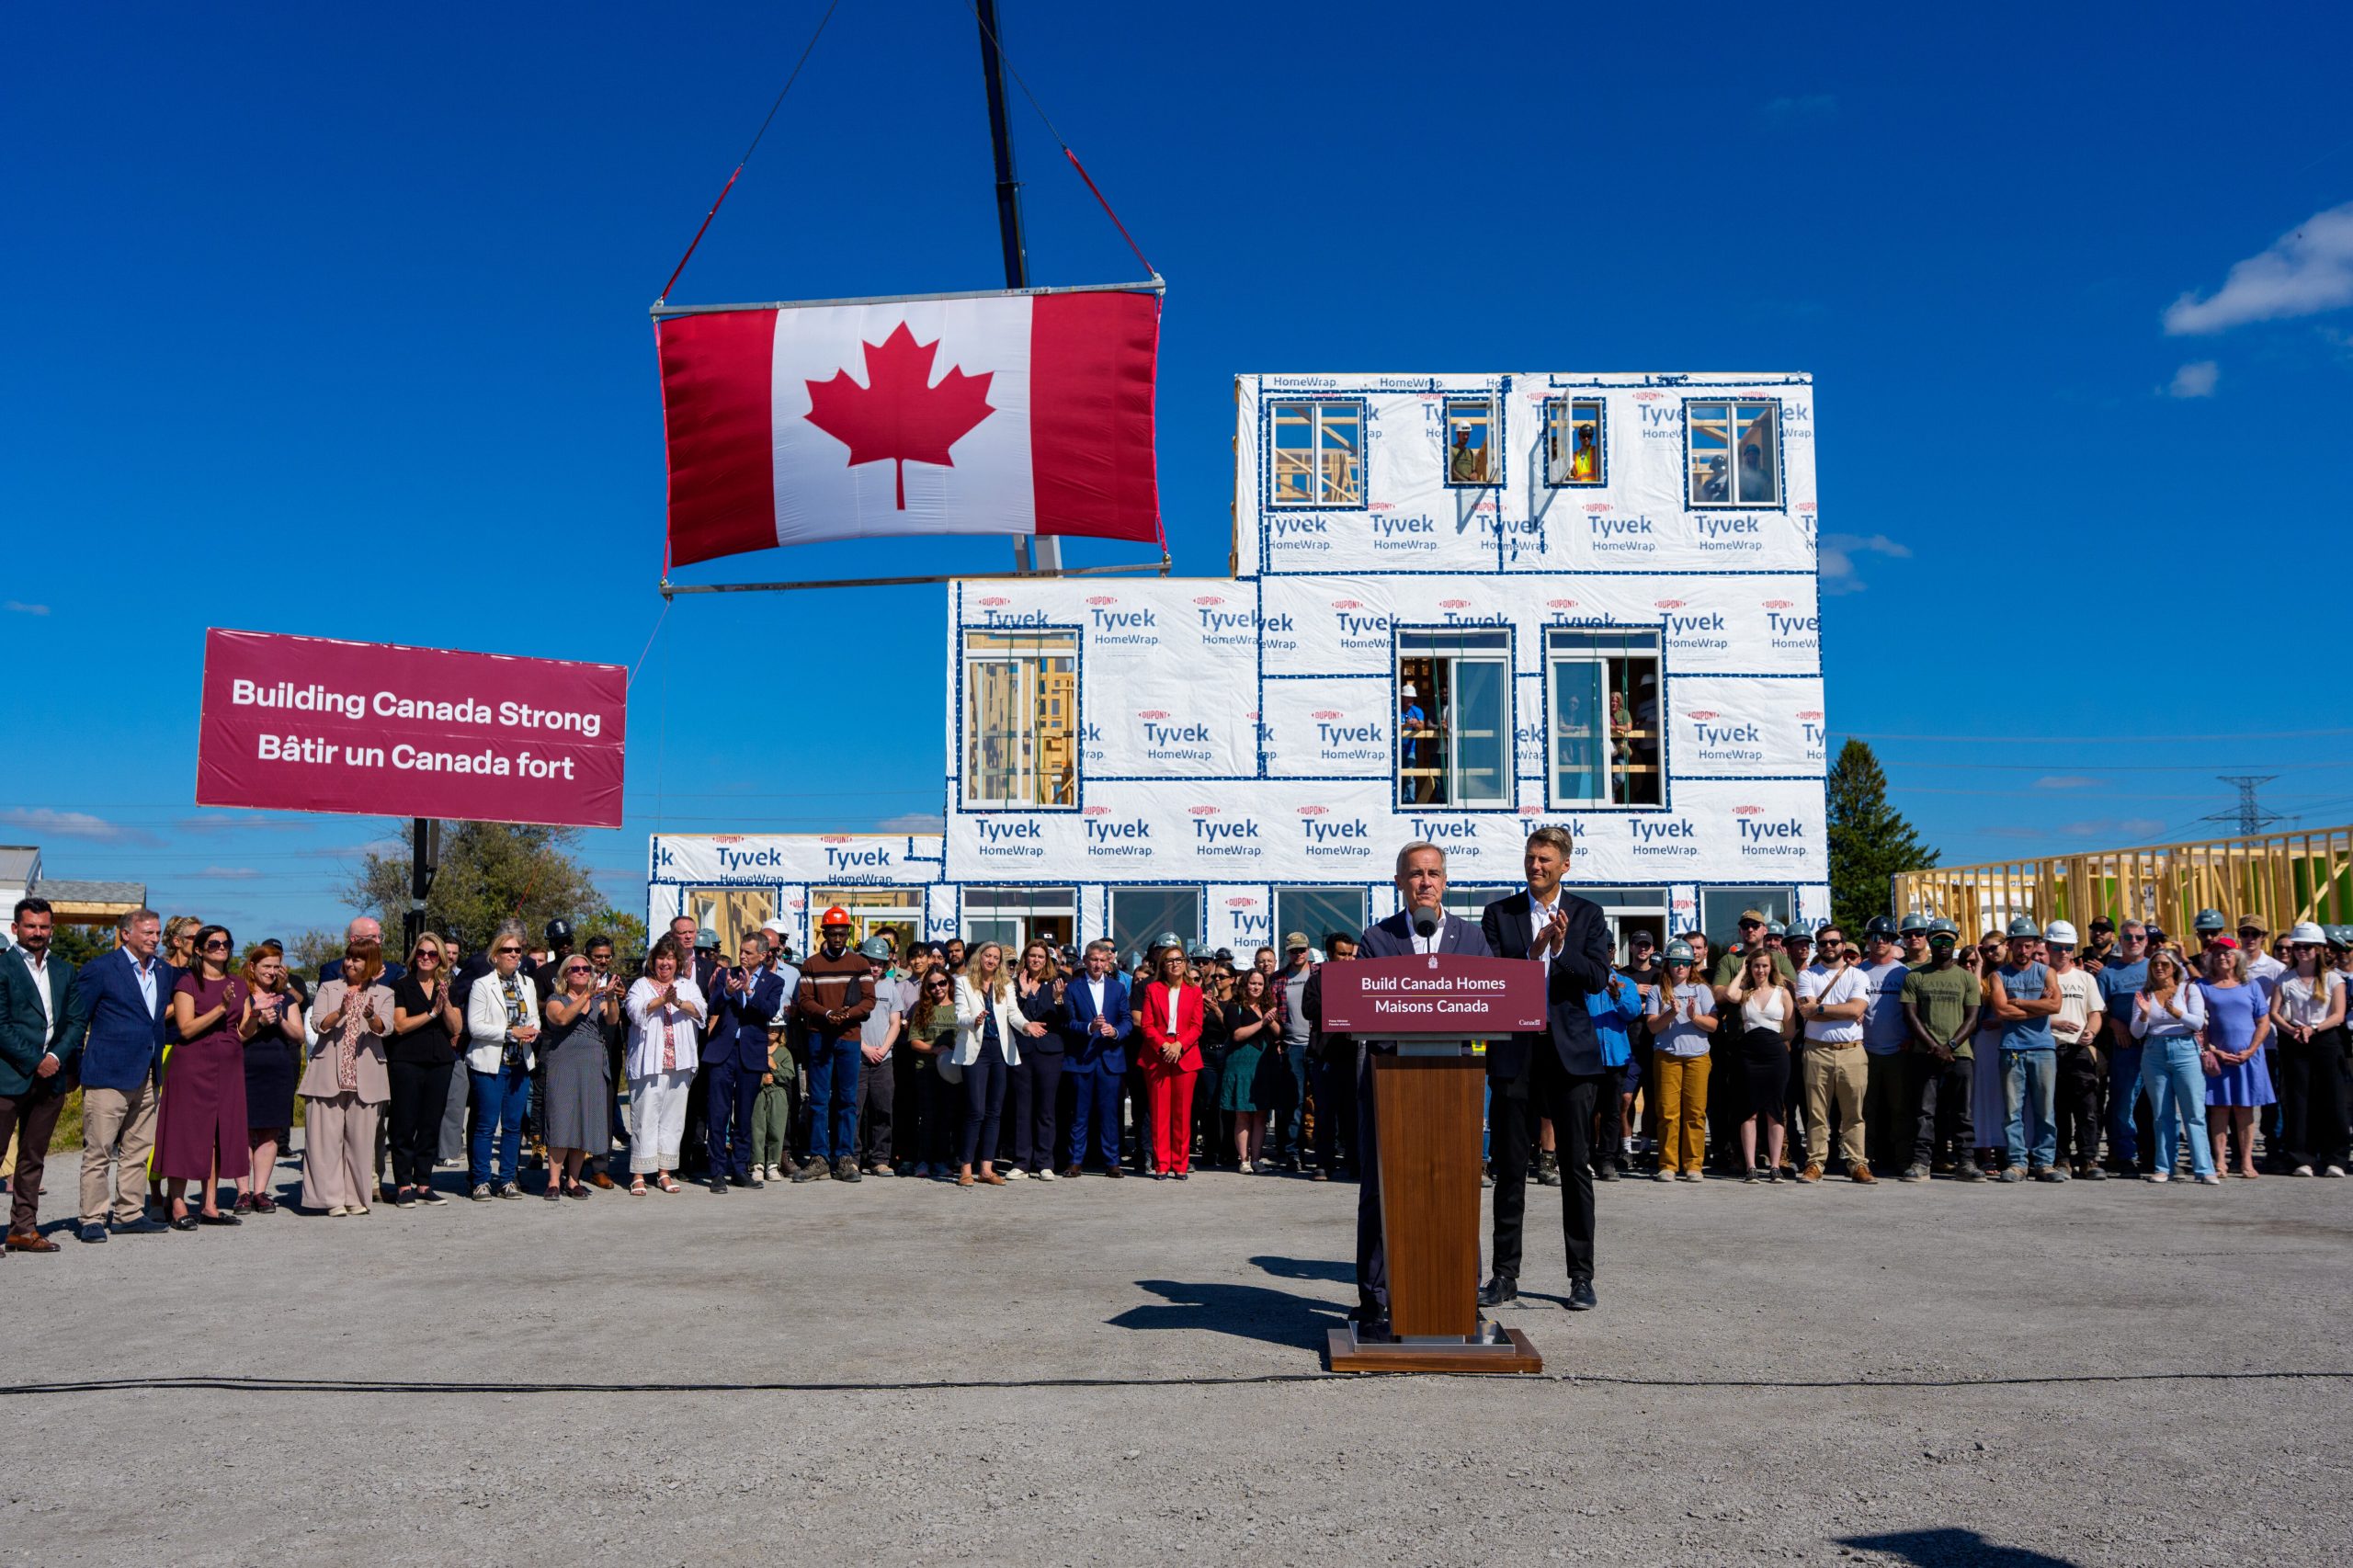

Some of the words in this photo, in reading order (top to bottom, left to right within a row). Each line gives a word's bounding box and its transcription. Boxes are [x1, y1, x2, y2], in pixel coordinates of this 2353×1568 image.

[1274, 377, 1336, 388] HomeWrap
[1380, 378, 1443, 389] HomeWrp
[1638, 403, 1683, 426] Tyve
[1799, 503, 1816, 512] DUPO
[1263, 514, 1327, 538] Tyvek
[1370, 514, 1435, 538] Tyvek
[1587, 515, 1653, 539] Tyvek
[1694, 515, 1759, 539] Tyvek
[1374, 540, 1438, 552] HomeWrap
[1592, 540, 1656, 552] HomeWrap
[1699, 540, 1762, 551] HomeWrap
[1091, 608, 1156, 632] Tyvek
[1659, 612, 1724, 636] Tyvek
[1767, 612, 1818, 636] Tyve
[1095, 634, 1159, 646] HomeWrap
[1202, 634, 1258, 645] HomeWra
[1261, 639, 1297, 651] eWrap
[1340, 639, 1392, 648] HomeWr
[1771, 639, 1817, 648] HomeW
[232, 678, 366, 720] Building
[372, 690, 492, 725] Canada
[498, 701, 601, 737] Strong
[1142, 710, 1167, 720] DUPONT
[1314, 710, 1341, 720] DUPONT
[1143, 722, 1209, 747] Tyvek
[1317, 722, 1382, 747] Tyvek
[1694, 722, 1759, 747] Tyvek
[257, 733, 338, 764] Bâtir
[345, 747, 384, 767] un
[392, 744, 510, 777] Canada
[517, 751, 574, 780] fort
[1148, 749, 1211, 761] HomeWrap
[1321, 749, 1385, 761] HomeWrap
[1699, 749, 1763, 761] HomeWrap
[1192, 806, 1217, 815] DUPONT
[1301, 806, 1326, 815] DUPONT
[975, 818, 1040, 843] Tyvek
[1084, 818, 1150, 843] Tyvek
[1192, 818, 1258, 843] Tyvek
[1302, 818, 1368, 843] Tyvek
[1410, 818, 1477, 843] Tyvek
[1628, 818, 1694, 843] Tyvek
[1737, 818, 1802, 843] Tyvek
[979, 845, 1043, 858] HomeWrap
[1087, 845, 1153, 857] HomeWrap
[1197, 845, 1261, 857] HomeWrap
[1306, 845, 1370, 858] HomeWrap
[1443, 845, 1480, 857] eWrap
[1632, 845, 1698, 857] HomeWrap
[1742, 845, 1806, 857] HomeWrap
[716, 847, 781, 871] Tyvek
[824, 846, 890, 871] Tyvek
[1229, 897, 1254, 907] DUPONT
[1673, 900, 1692, 909] UPONT
[1230, 910, 1268, 935] Tyv
[1233, 937, 1268, 948] Home
[1361, 976, 1397, 991] Build
[1401, 976, 1452, 991] Canada
[1456, 976, 1506, 990] Homes
[1375, 999, 1434, 1013] Maisons
[1437, 999, 1489, 1013] Canada
